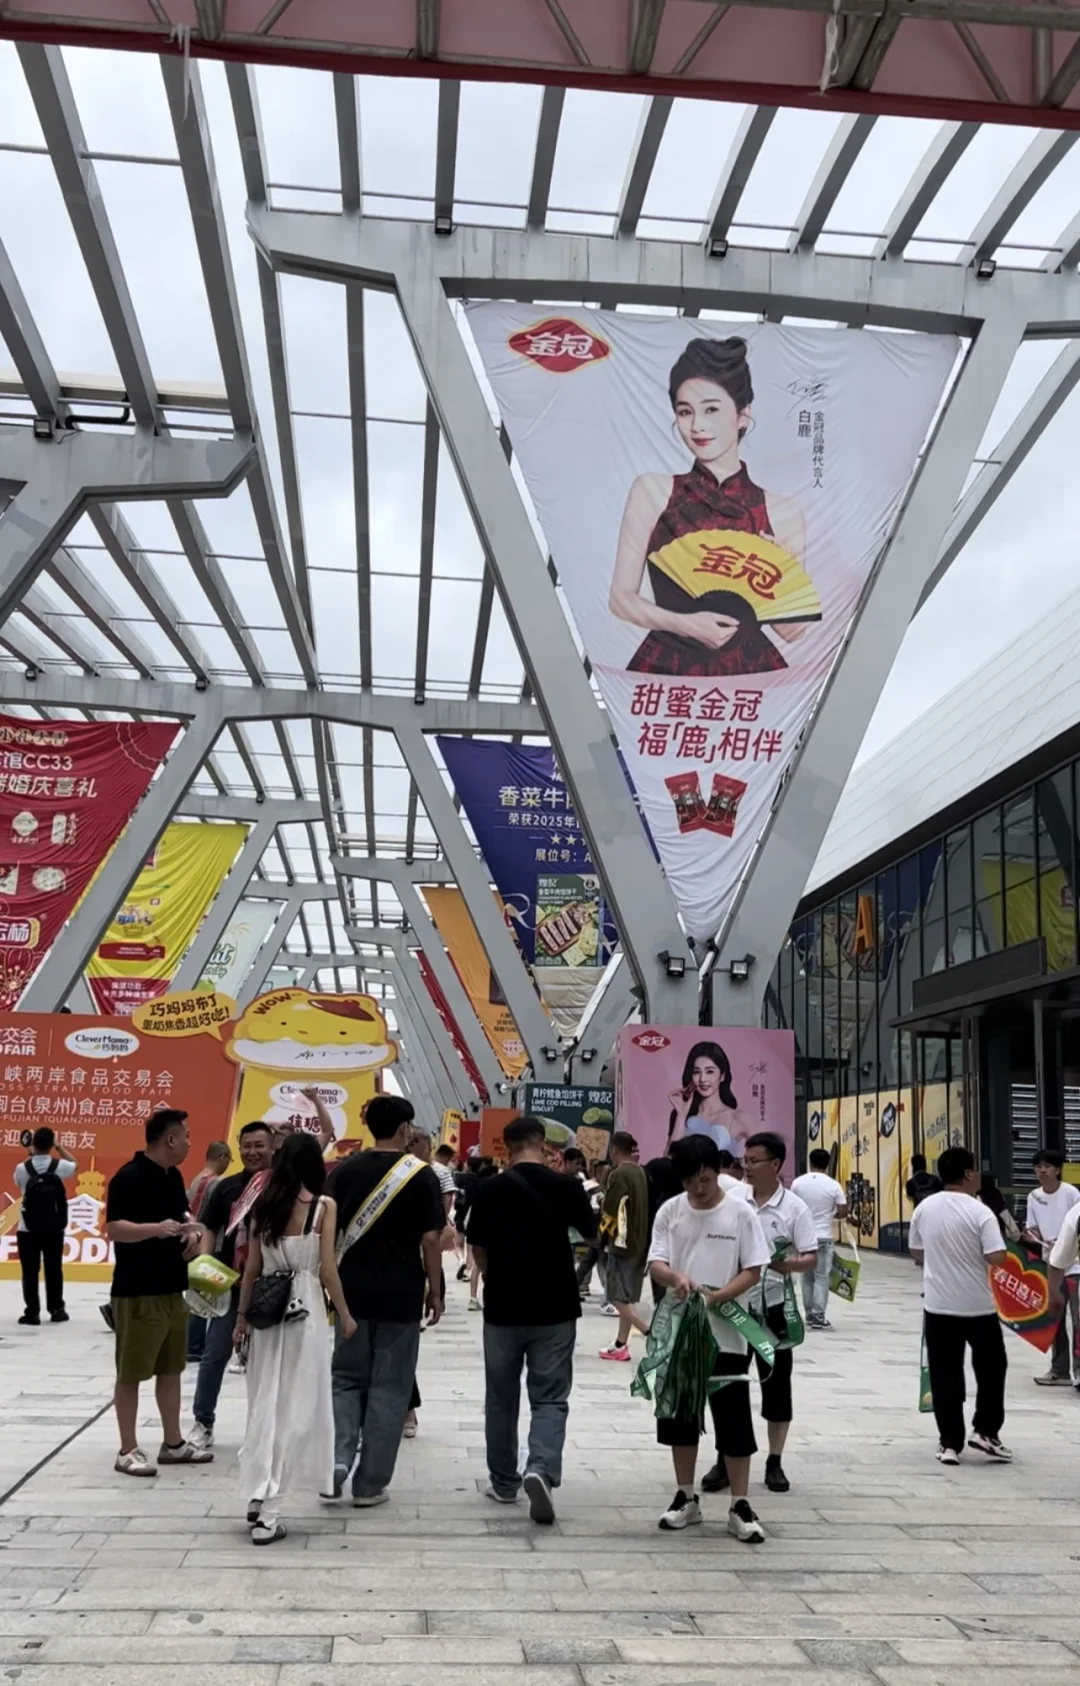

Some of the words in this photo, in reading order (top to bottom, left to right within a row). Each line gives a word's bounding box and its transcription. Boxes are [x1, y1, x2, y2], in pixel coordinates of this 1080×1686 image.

[525, 332, 594, 359] 金冠
[798, 410, 811, 437] 白鹿
[812, 411, 824, 488] 金冠品牌代言人
[693, 543, 783, 600] 金冠
[631, 683, 763, 722] 甜蜜金冠
[0, 751, 73, 771] 馆CC33
[499, 786, 572, 809] 香菜牛
[508, 812, 580, 829] 荣获2025年
[149, 994, 217, 1017] 巧妈妈布丁
[0, 1027, 38, 1045] 交会
[102, 1044, 129, 1052] 巧妈妈
[93, 1086, 131, 1095] FOOD
[141, 1088, 172, 1097] FAIR
